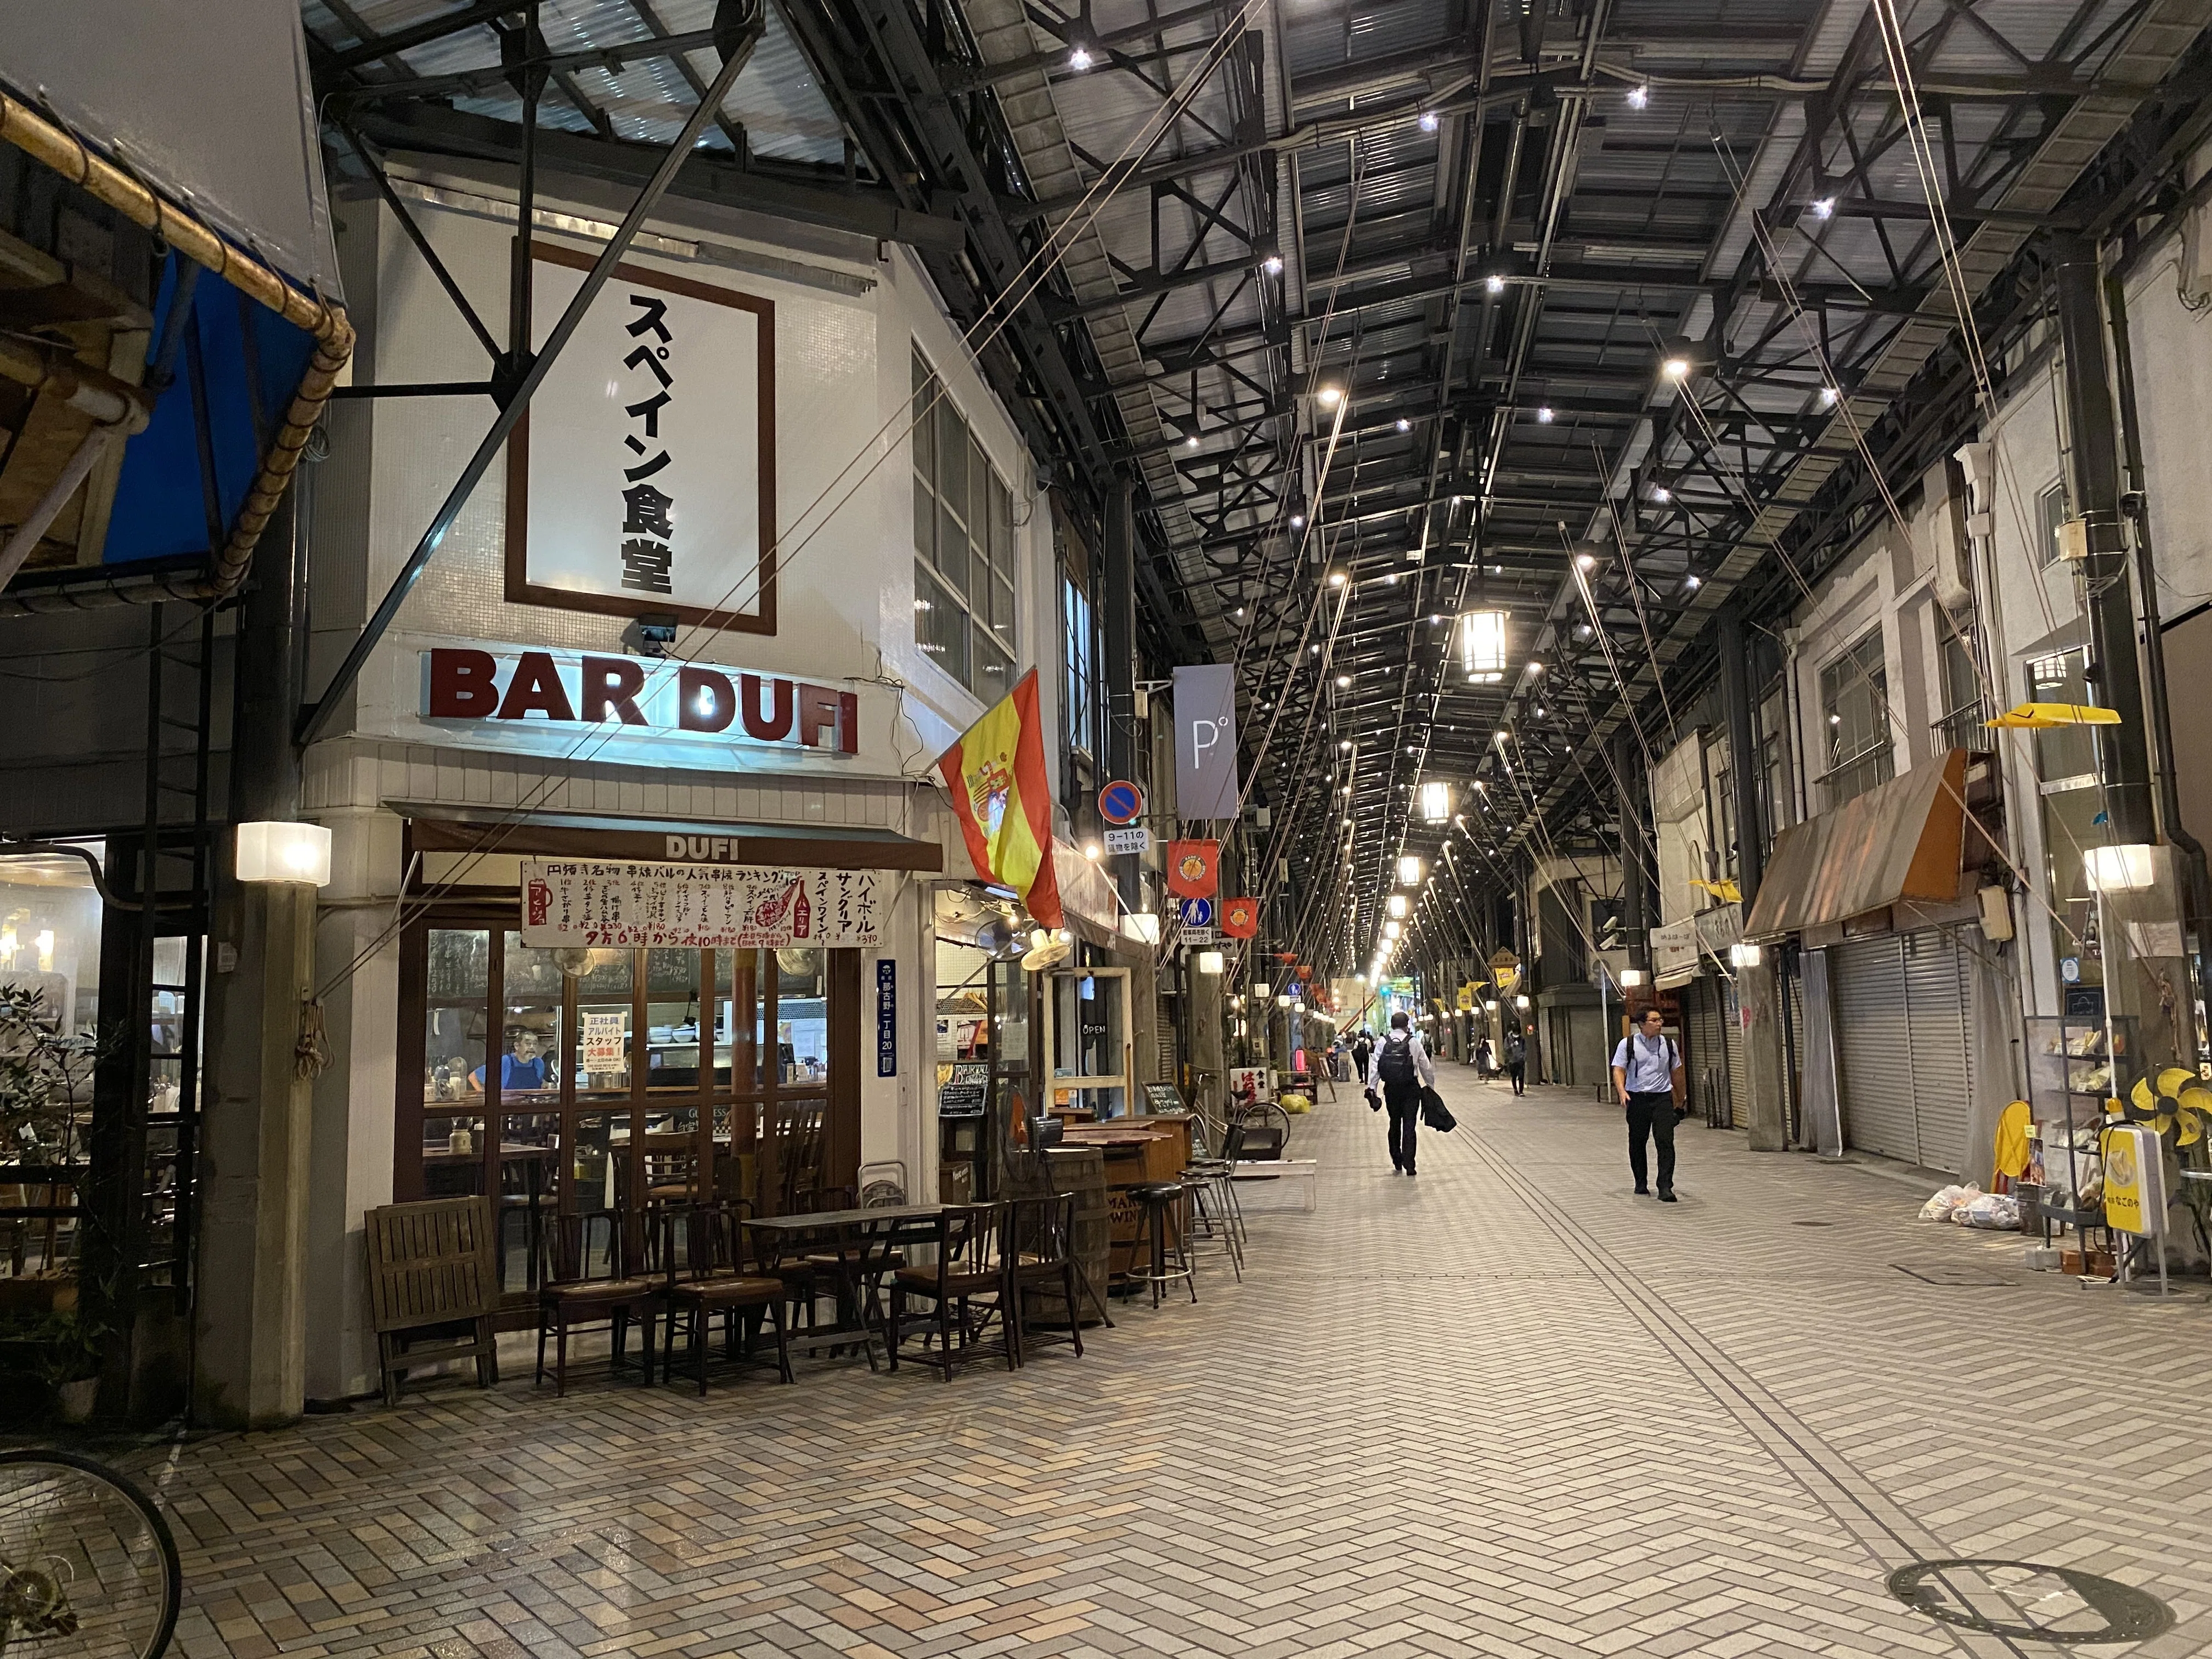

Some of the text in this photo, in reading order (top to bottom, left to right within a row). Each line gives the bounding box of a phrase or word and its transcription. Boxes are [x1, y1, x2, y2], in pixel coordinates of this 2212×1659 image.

[620, 294, 673, 595] スペイン食堂
[430, 648, 859, 754] BAR DUFI
[665, 835, 740, 861] DUFI
[815, 872, 829, 933] スペインワイン
[836, 872, 853, 933] サングリア
[856, 875, 876, 934] ハイボール
[586, 1037, 622, 1046] スタッフ
[588, 1026, 621, 1035] アルバイト
[589, 1017, 619, 1025] 正社員
[1082, 1025, 1105, 1034] OPEN
